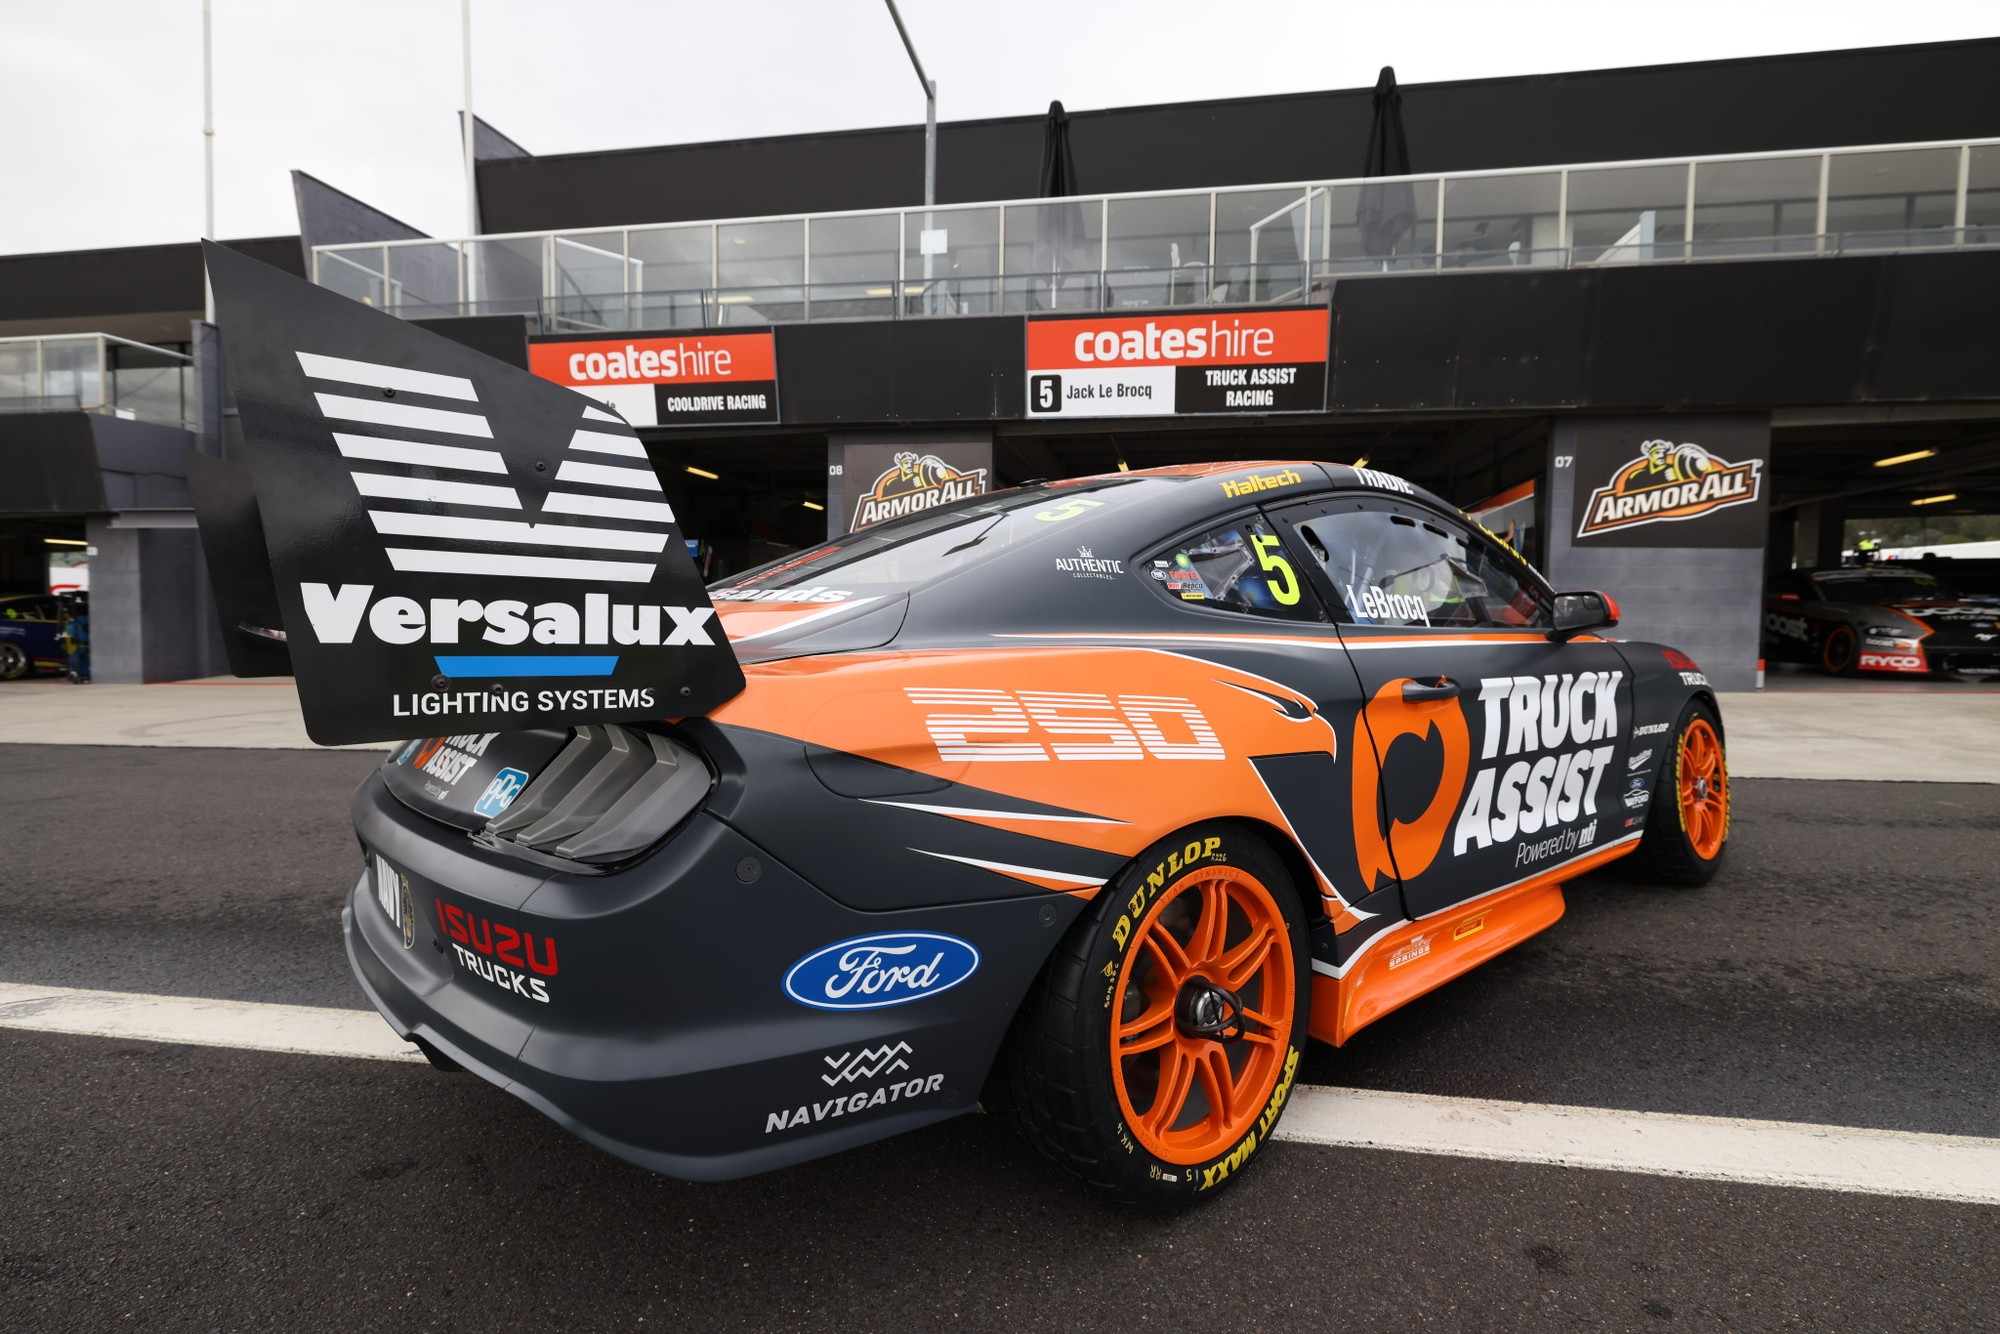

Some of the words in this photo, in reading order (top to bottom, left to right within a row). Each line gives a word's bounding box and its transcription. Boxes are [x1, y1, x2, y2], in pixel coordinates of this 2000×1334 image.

[1039, 379, 1053, 408] 5
[1066, 384, 1095, 400] Jack
[1099, 383, 1113, 398] Le
[1117, 383, 1152, 400] Brocq
[1205, 368, 1248, 387] TRUCK
[1250, 367, 1297, 385] ASSIST
[667, 395, 725, 412] COOLDRIVE
[727, 394, 767, 410] RACING
[1226, 389, 1274, 407] RACING
[829, 465, 843, 475] 08
[1555, 456, 1573, 468] 07
[1219, 469, 1302, 498] Haltech
[1056, 558, 1124, 575] AUTHENTIC
[1250, 534, 1301, 606] 5
[300, 582, 717, 646] Versalux
[1346, 584, 1431, 627] LeBrocq
[1860, 654, 1921, 668] RYCO
[393, 690, 529, 717] LIGHTING
[537, 688, 655, 712] SYSTEMS
[1477, 671, 1624, 760] TRUCK
[902, 687, 1226, 762] 250
[422, 746, 478, 786] ASSIST
[483, 774, 521, 810] PPG
[1454, 745, 1615, 857] ASSIST
[1515, 834, 1563, 868] Powered
[1564, 828, 1580, 851] by
[1112, 837, 1221, 952] DUNLOP
[435, 898, 558, 976] ISUZU
[1389, 944, 1430, 968] SPRINGS
[452, 943, 550, 1003] TRUCKS
[825, 944, 945, 999] Ford
[765, 1073, 944, 1134] NAVIGATOR
[1259, 1045, 1299, 1142] SPORT
[1199, 1130, 1257, 1191] MAXX
